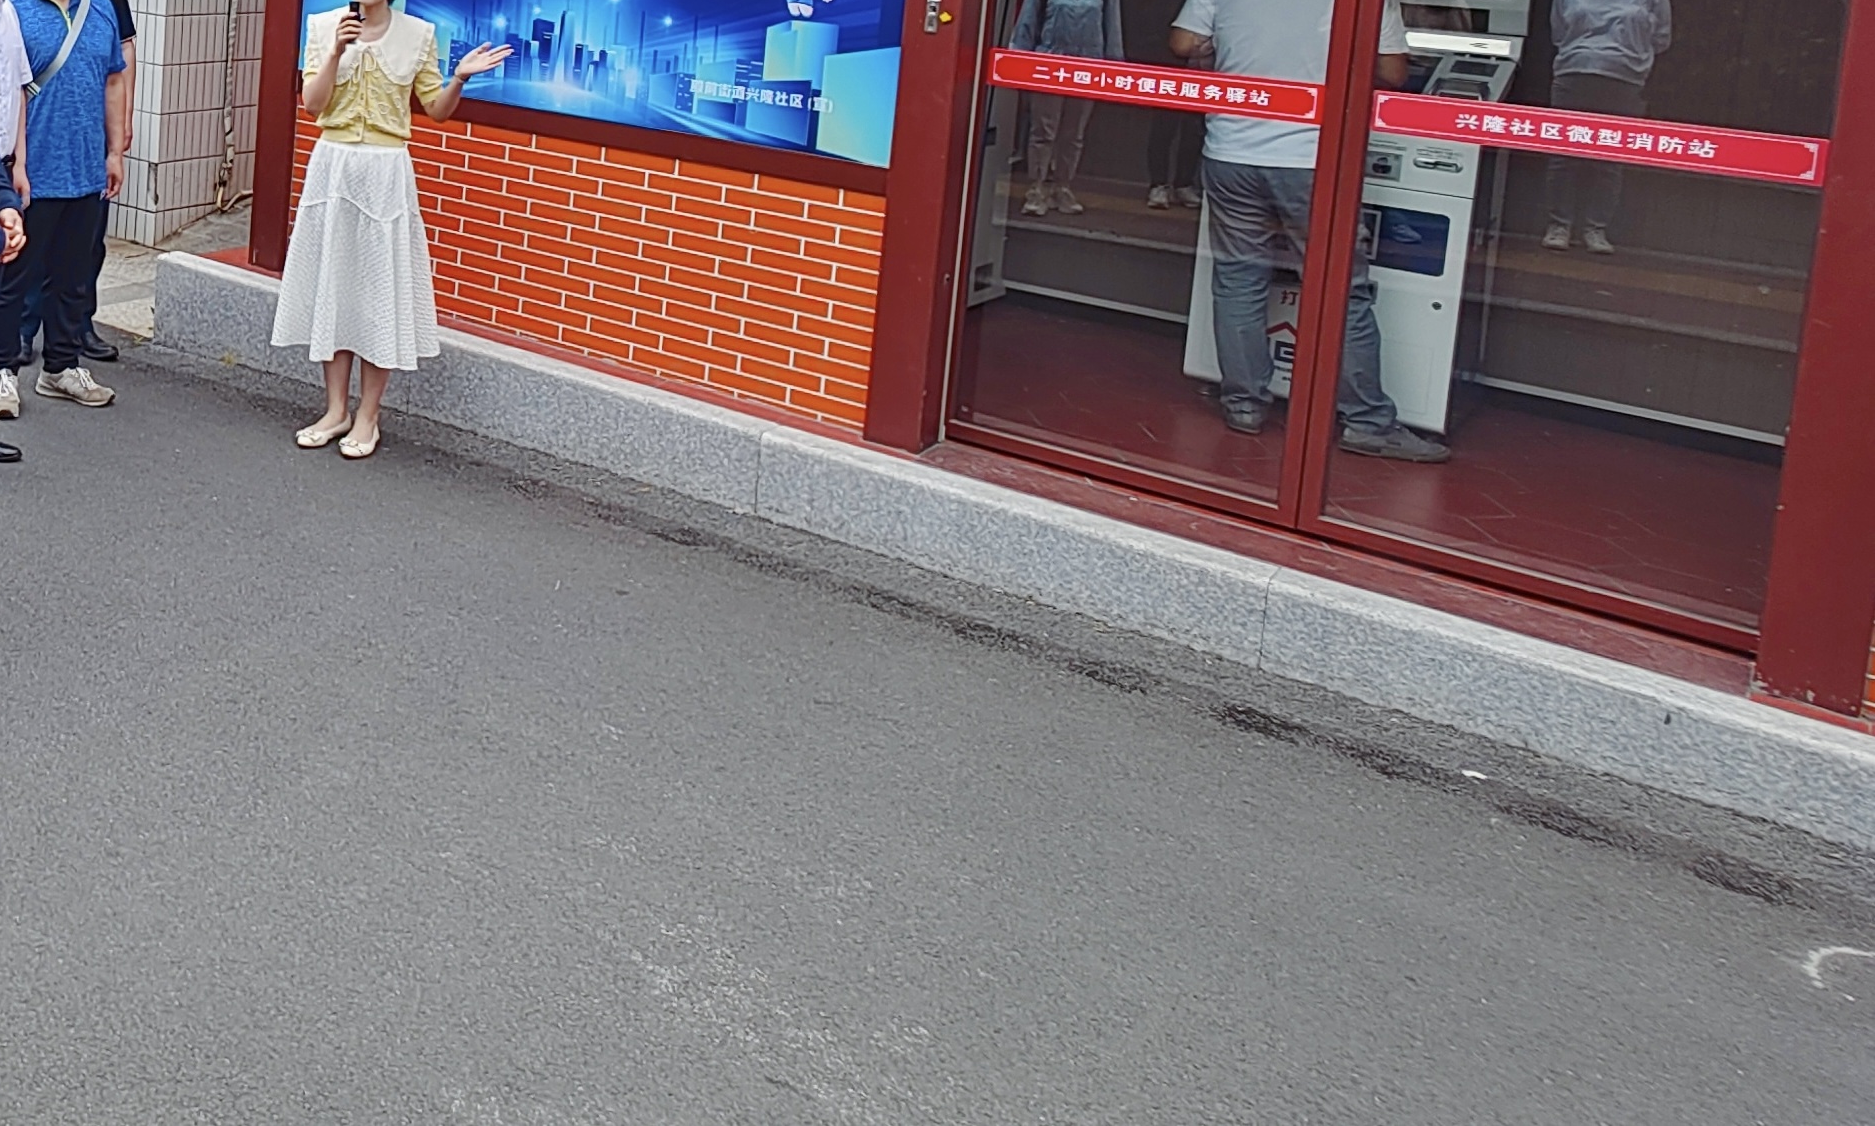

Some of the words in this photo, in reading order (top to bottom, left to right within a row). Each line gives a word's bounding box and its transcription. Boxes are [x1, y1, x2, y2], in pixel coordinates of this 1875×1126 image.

[1031, 65, 1272, 106] 二十四小时便民服务驿站
[1454, 113, 1719, 158] 兴隆社区微型消防站
